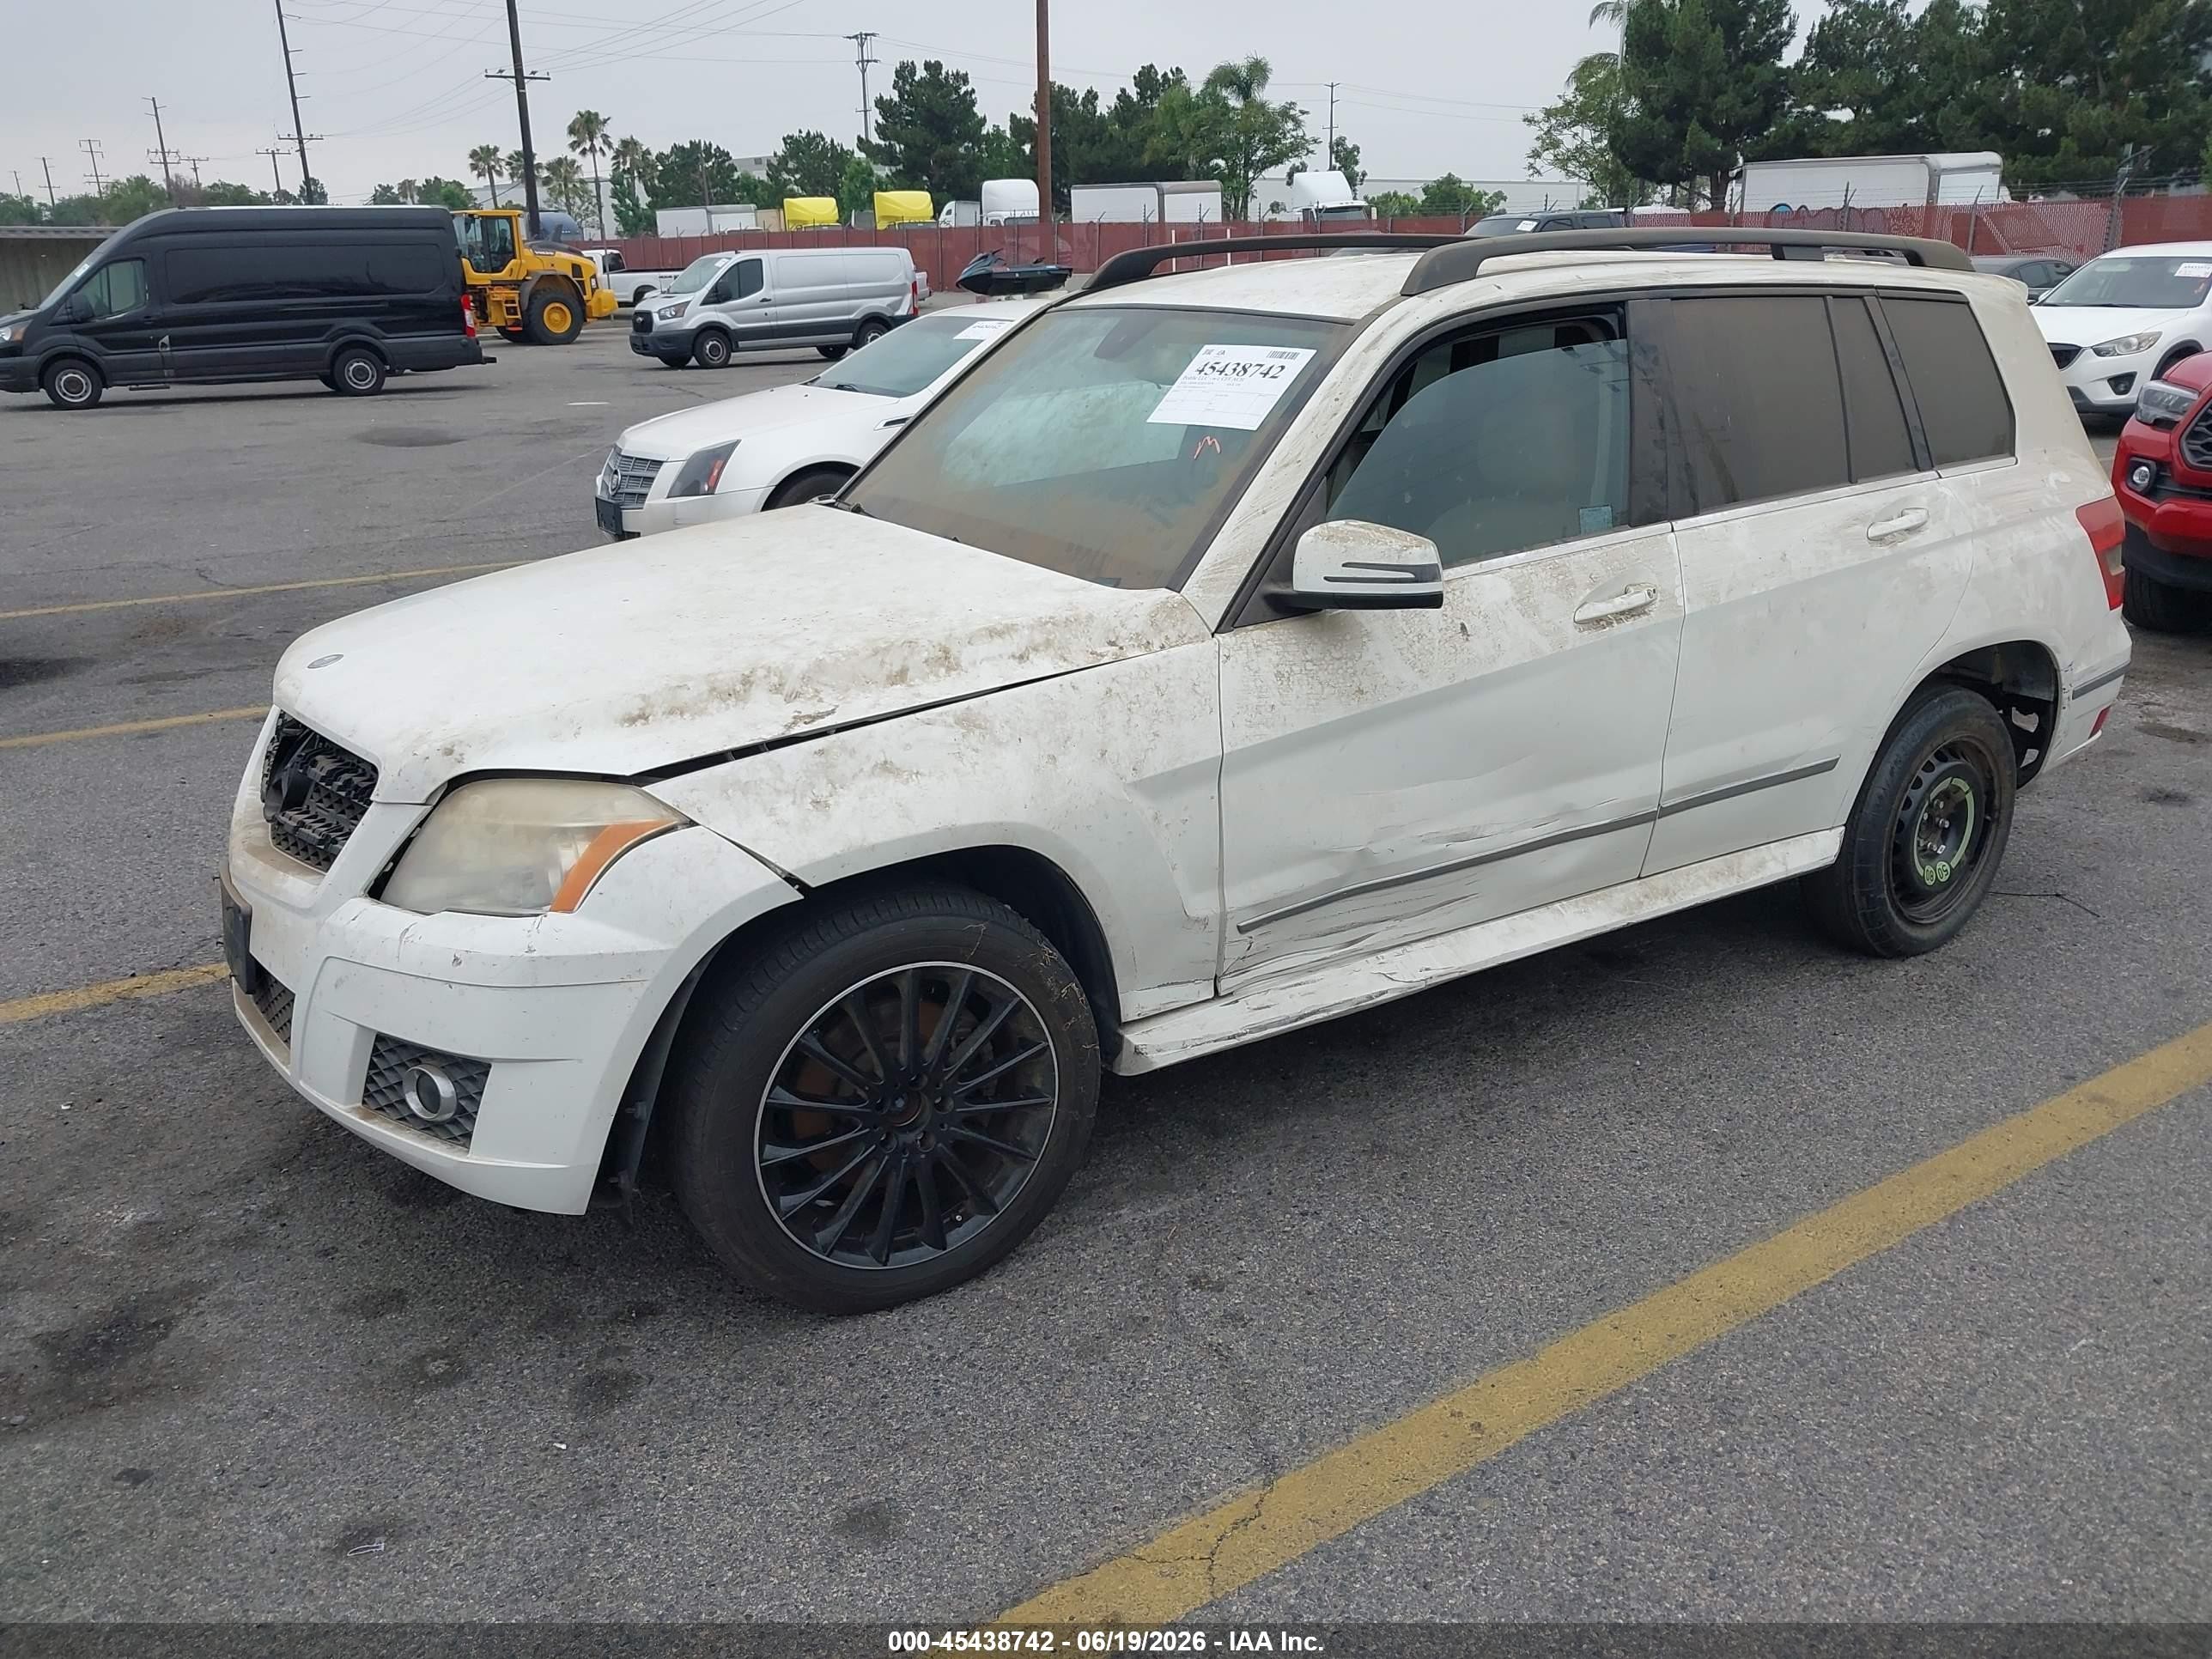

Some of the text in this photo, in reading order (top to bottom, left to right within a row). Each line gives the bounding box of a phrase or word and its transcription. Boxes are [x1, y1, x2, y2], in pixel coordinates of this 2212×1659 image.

[1195, 362, 1285, 379] 45438742
[1925, 869, 1934, 882] 80
[1937, 865, 1948, 879] 50
